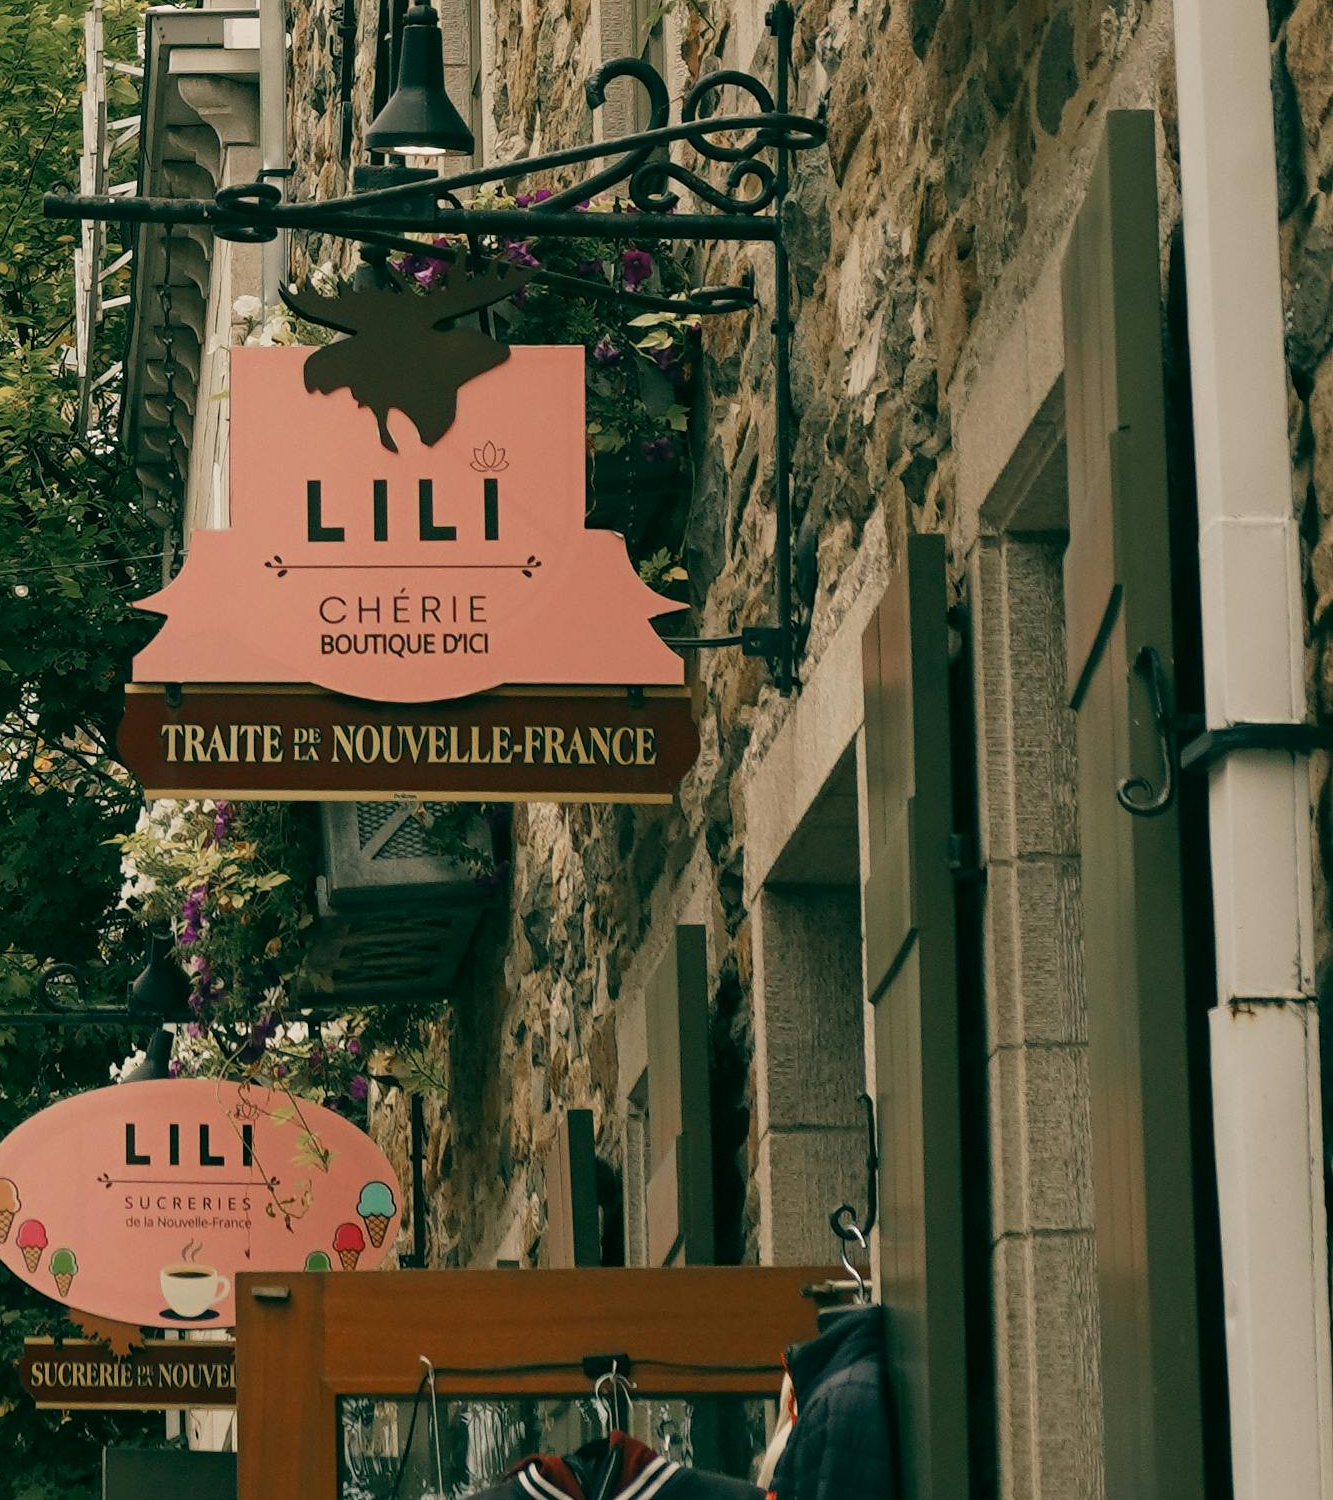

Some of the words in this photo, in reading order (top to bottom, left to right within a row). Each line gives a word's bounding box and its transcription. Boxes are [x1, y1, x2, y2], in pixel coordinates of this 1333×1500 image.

[306, 477, 500, 543] LILI
[318, 587, 488, 625] CHÉRIE
[320, 633, 436, 659] BOUTIQUE
[442, 632, 490, 655] D'ICI
[160, 723, 284, 764] TRAITE
[293, 727, 323, 745] DE
[332, 723, 658, 767] NOUVELLE-FRANCE
[293, 744, 320, 763] LA
[125, 1122, 254, 1167] LILI
[124, 1196, 252, 1212] SUCRERIES
[125, 1215, 141, 1229] de
[143, 1215, 154, 1229] la
[156, 1215, 253, 1230] Nouvelle-France
[30, 1361, 134, 1389] SUCRERIE
